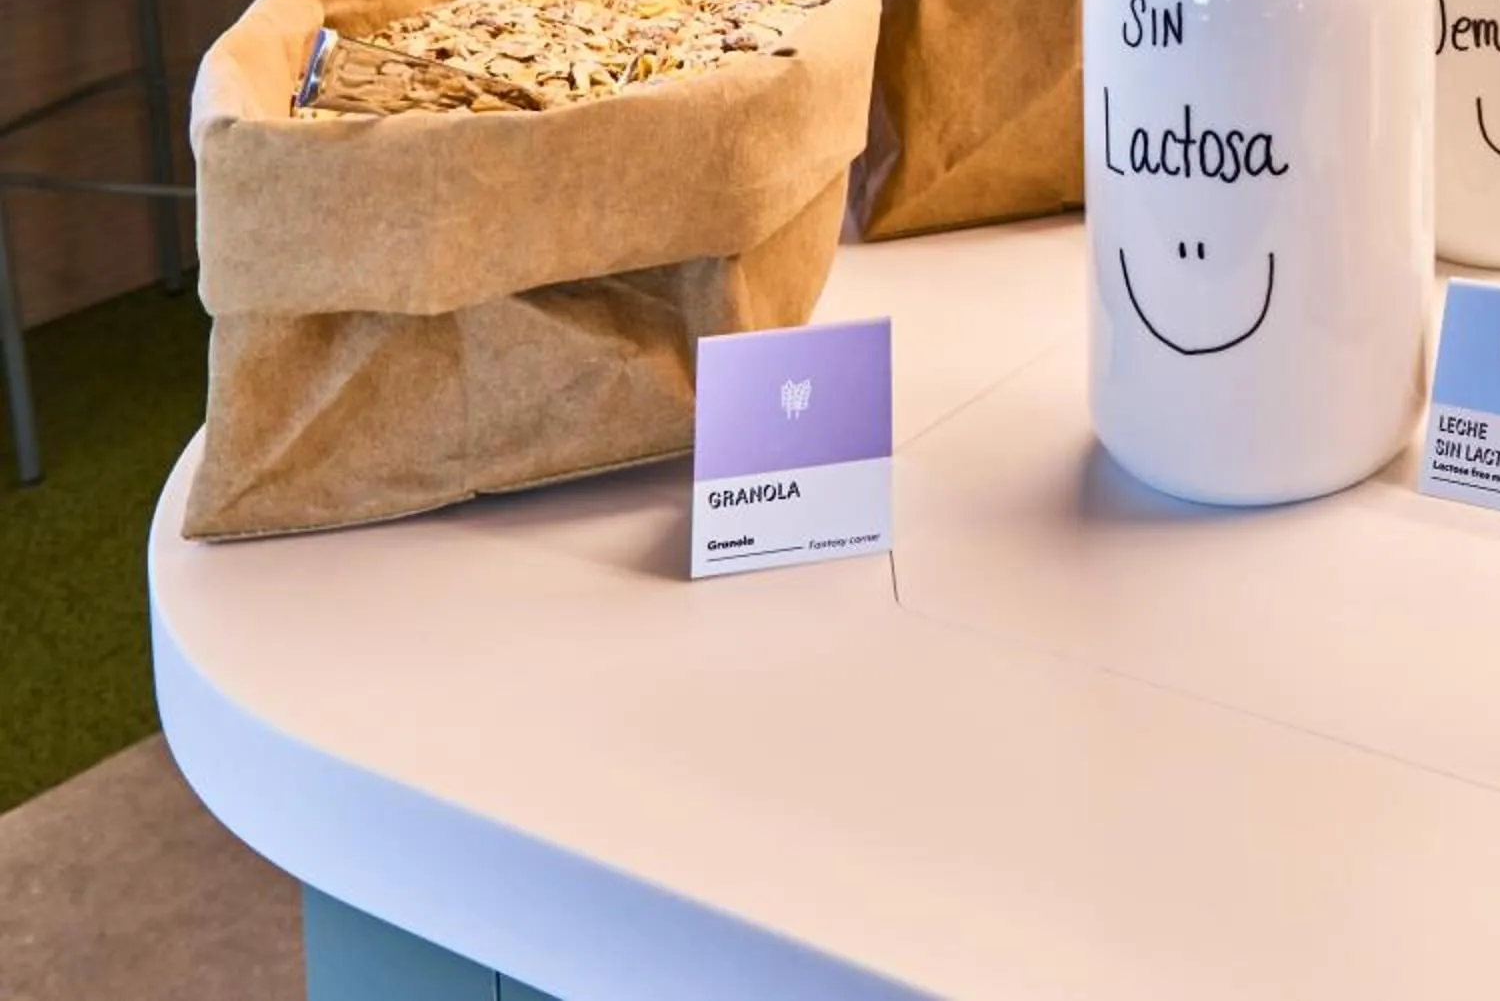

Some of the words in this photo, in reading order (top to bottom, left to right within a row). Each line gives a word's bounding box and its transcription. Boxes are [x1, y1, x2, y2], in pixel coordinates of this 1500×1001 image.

[1104, 86, 1289, 183] Lactosa
[1438, 414, 1489, 441] LECHE
[1435, 438, 1462, 459] SIN
[1432, 460, 1469, 477] Lactose
[1470, 467, 1491, 481] free
[708, 481, 801, 510] GRANOLA
[707, 536, 755, 551] Granola
